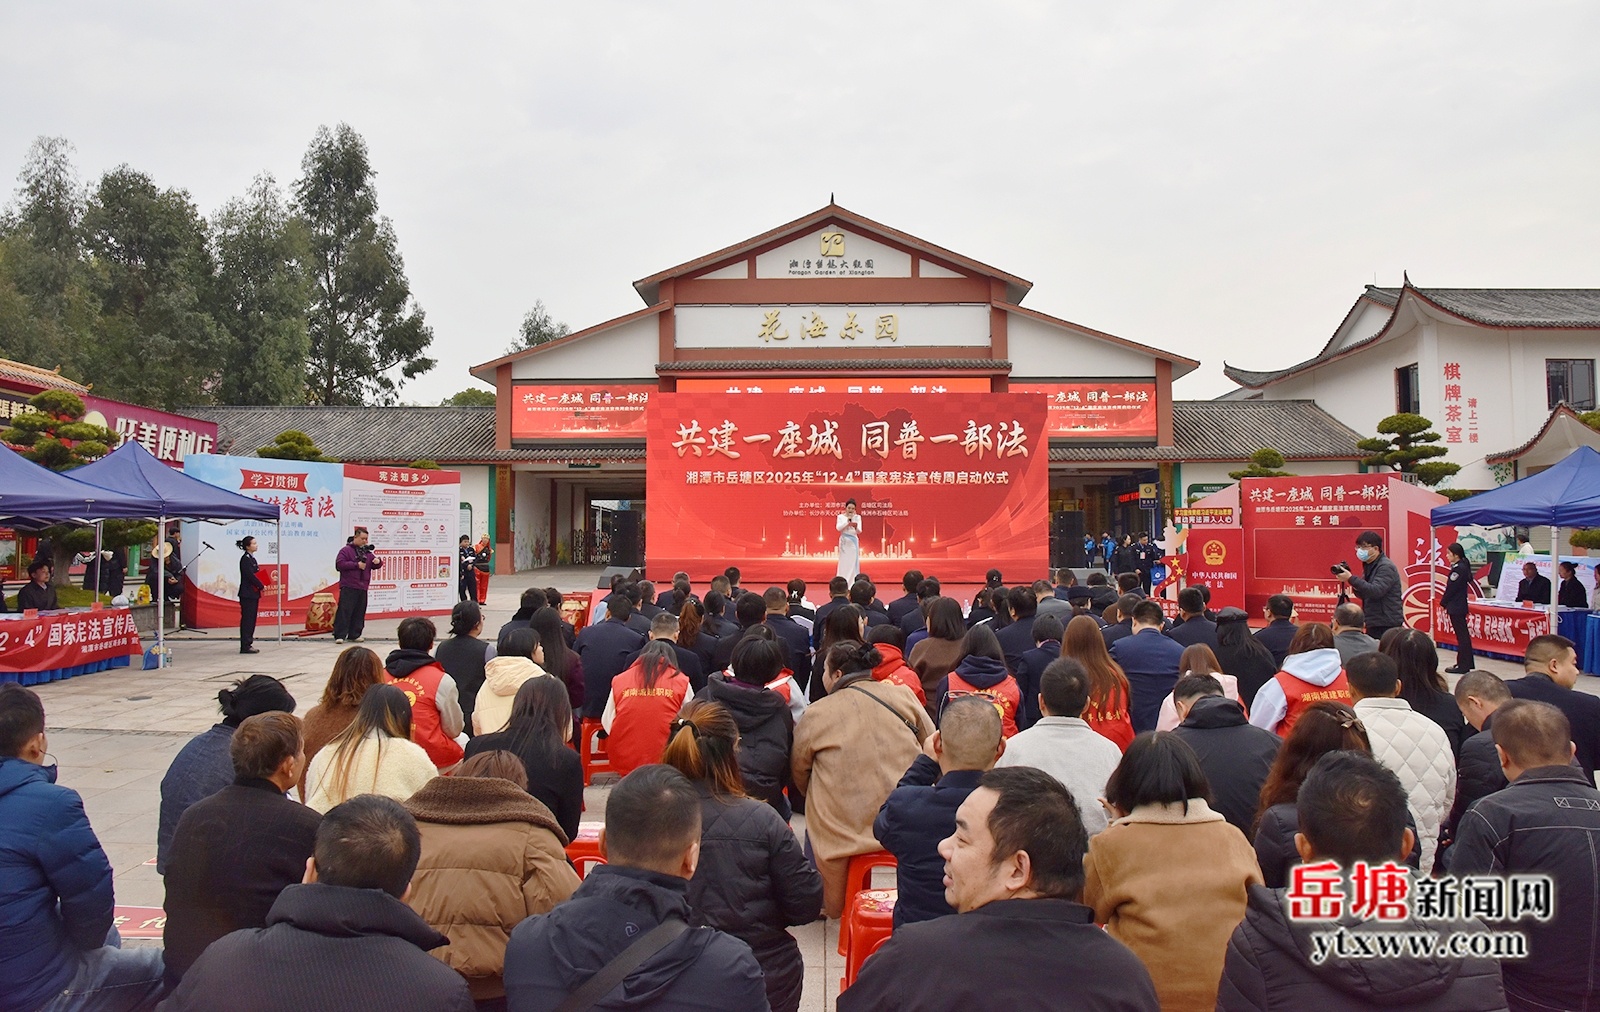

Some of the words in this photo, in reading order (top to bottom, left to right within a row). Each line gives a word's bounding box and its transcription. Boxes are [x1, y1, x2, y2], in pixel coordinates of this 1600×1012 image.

[758, 308, 899, 343] 花海乐园
[522, 392, 584, 405] 共建一座城
[590, 392, 649, 405] 同普一部法
[1086, 390, 1149, 403] 同普一部法
[1443, 362, 1463, 444] 棋牌茶室
[1467, 397, 1479, 444] 请上二楼
[671, 419, 843, 460] 共建一座城
[861, 419, 1029, 461] 同普一部法
[250, 473, 299, 488] 学习贯彻
[379, 471, 430, 483] 宪法知多少
[686, 470, 1009, 485] 湘潭市岳塘区2025年“12·4”国家宪法宣传周启动仪式
[1249, 485, 1315, 503] 共建一座城
[1320, 483, 1390, 502] 同普一部法
[1174, 516, 1233, 524] 推动宪法深入人心
[1191, 571, 1238, 580] 中华人民共和国
